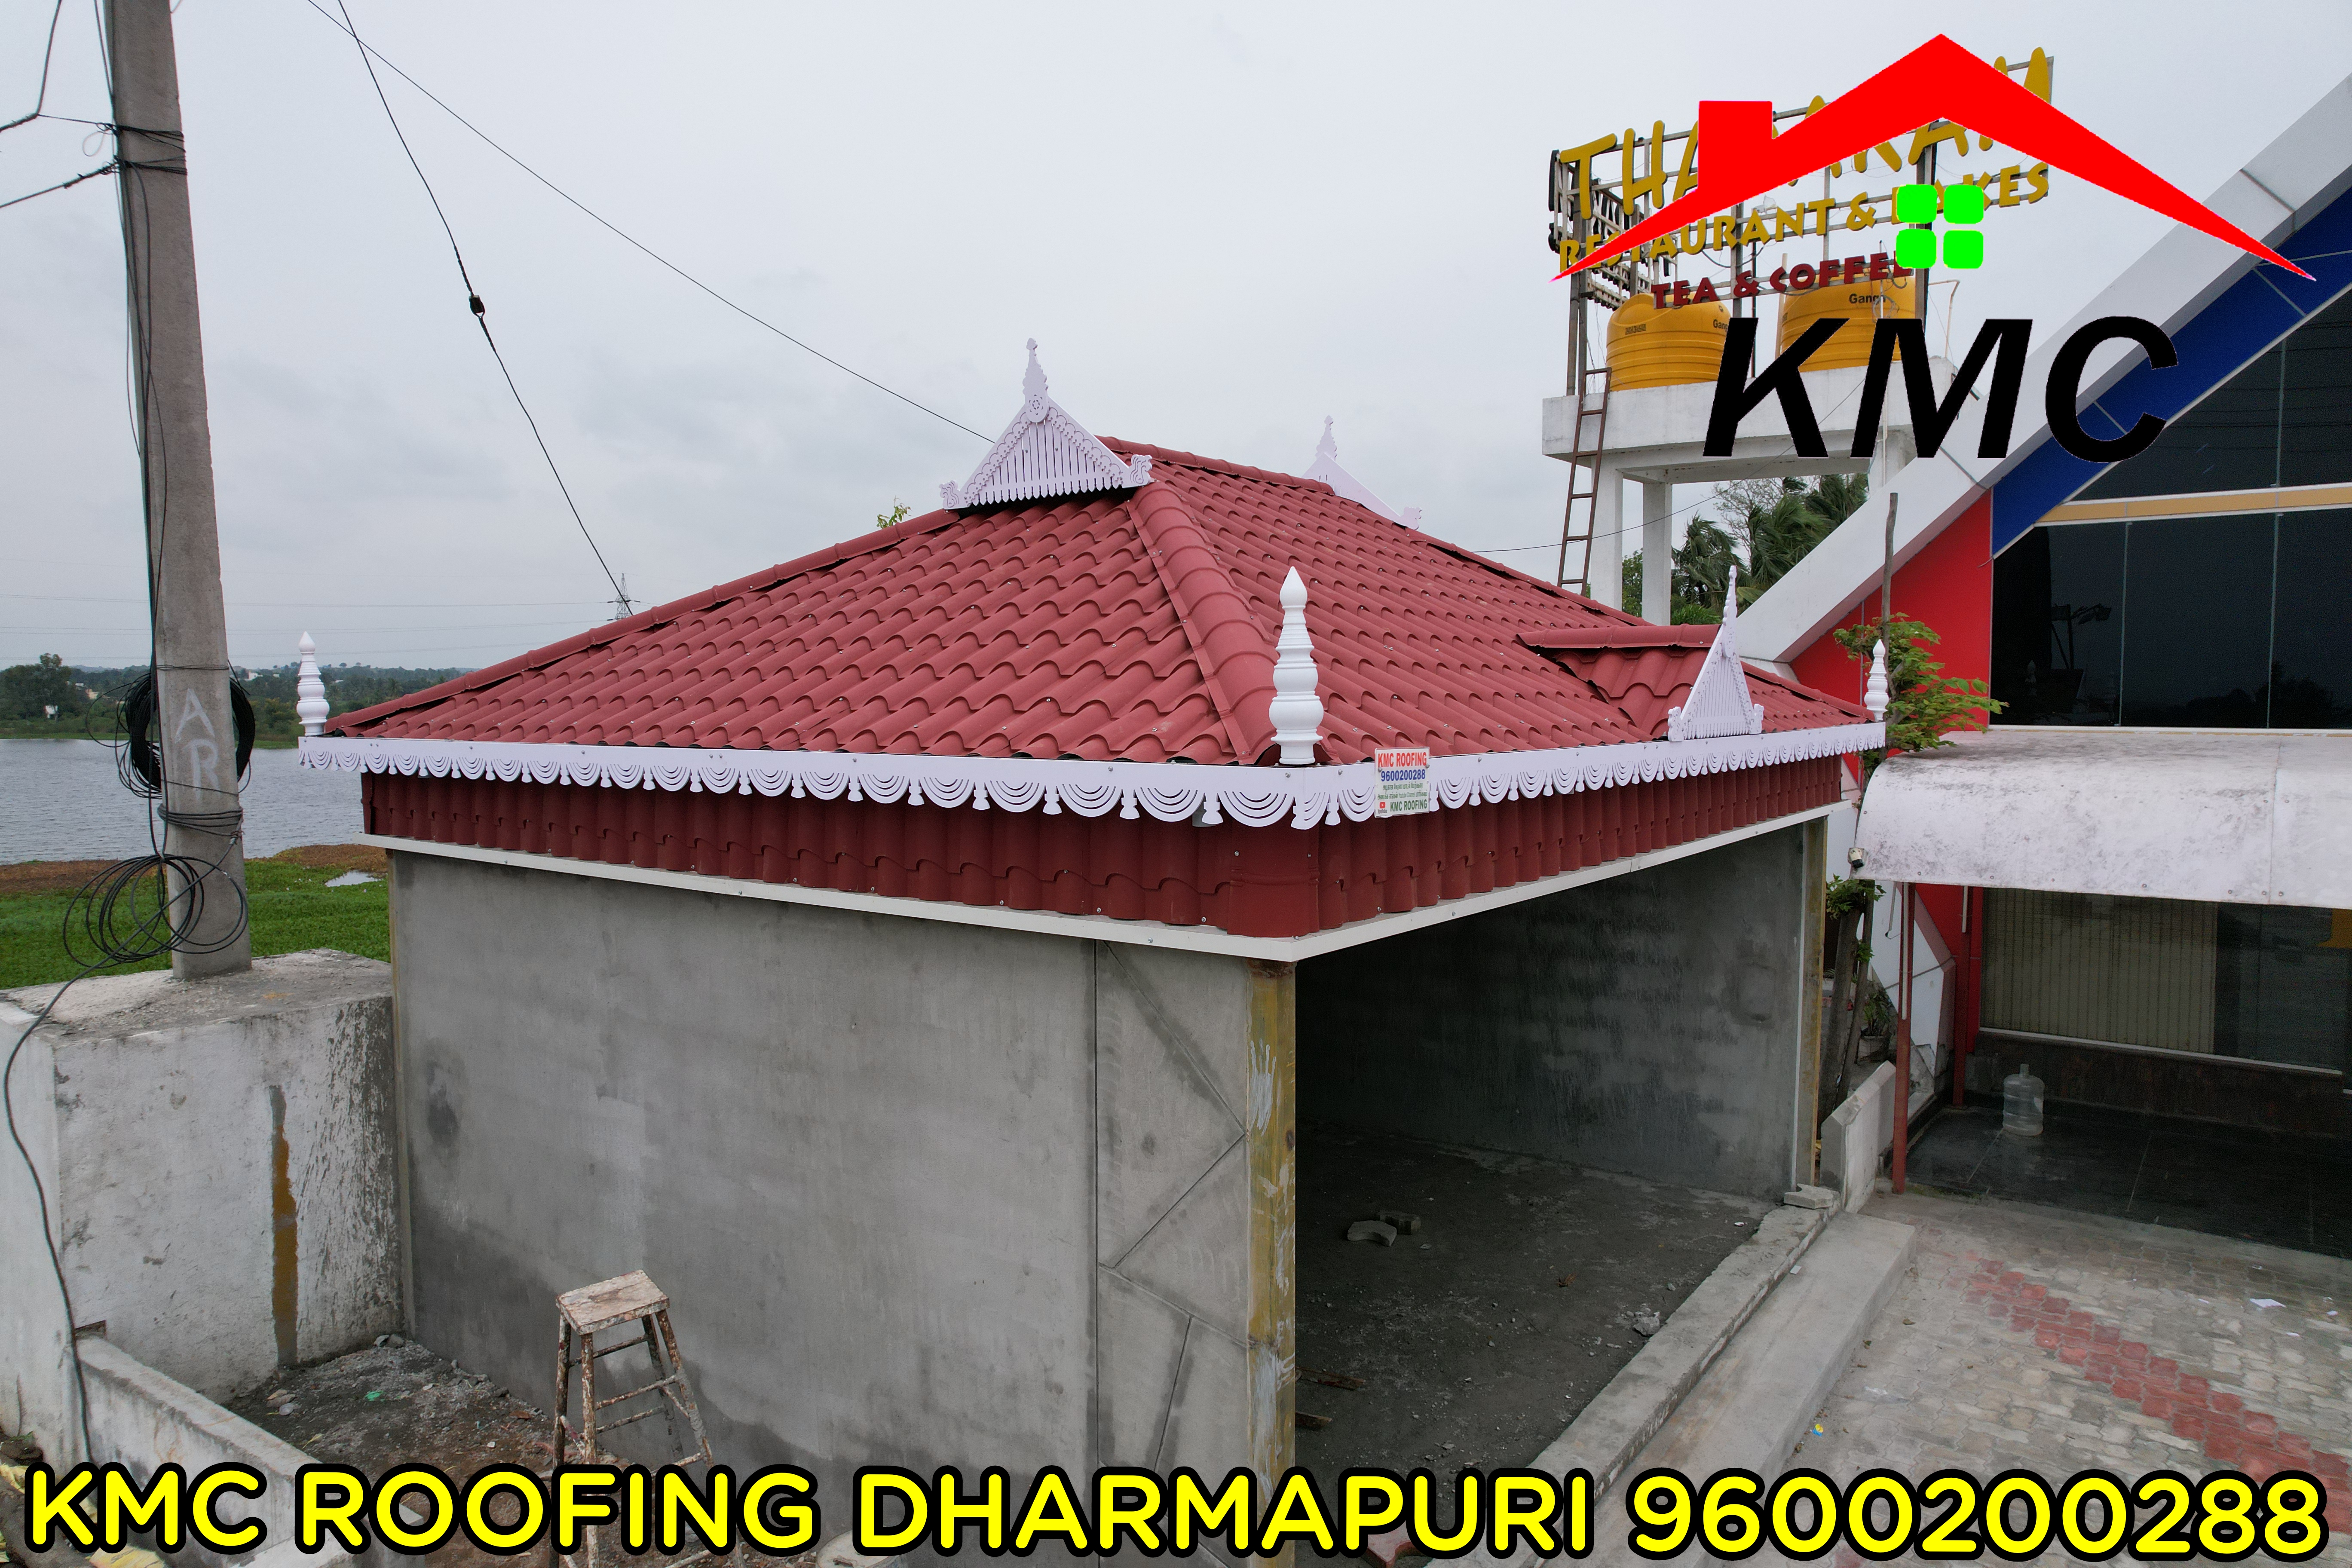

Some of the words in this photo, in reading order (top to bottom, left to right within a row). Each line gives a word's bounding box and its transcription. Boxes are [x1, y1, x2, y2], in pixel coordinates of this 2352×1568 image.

[1846, 191, 1877, 231] &
[1651, 277, 1719, 309] TEA
[1733, 270, 1760, 298] &
[1378, 753, 1394, 768] KMC
[1396, 752, 1427, 767] ROOFING
[1381, 769, 1426, 782] 9600200288
[1390, 801, 1403, 812] KMC
[1404, 799, 1427, 811] ROOFING
